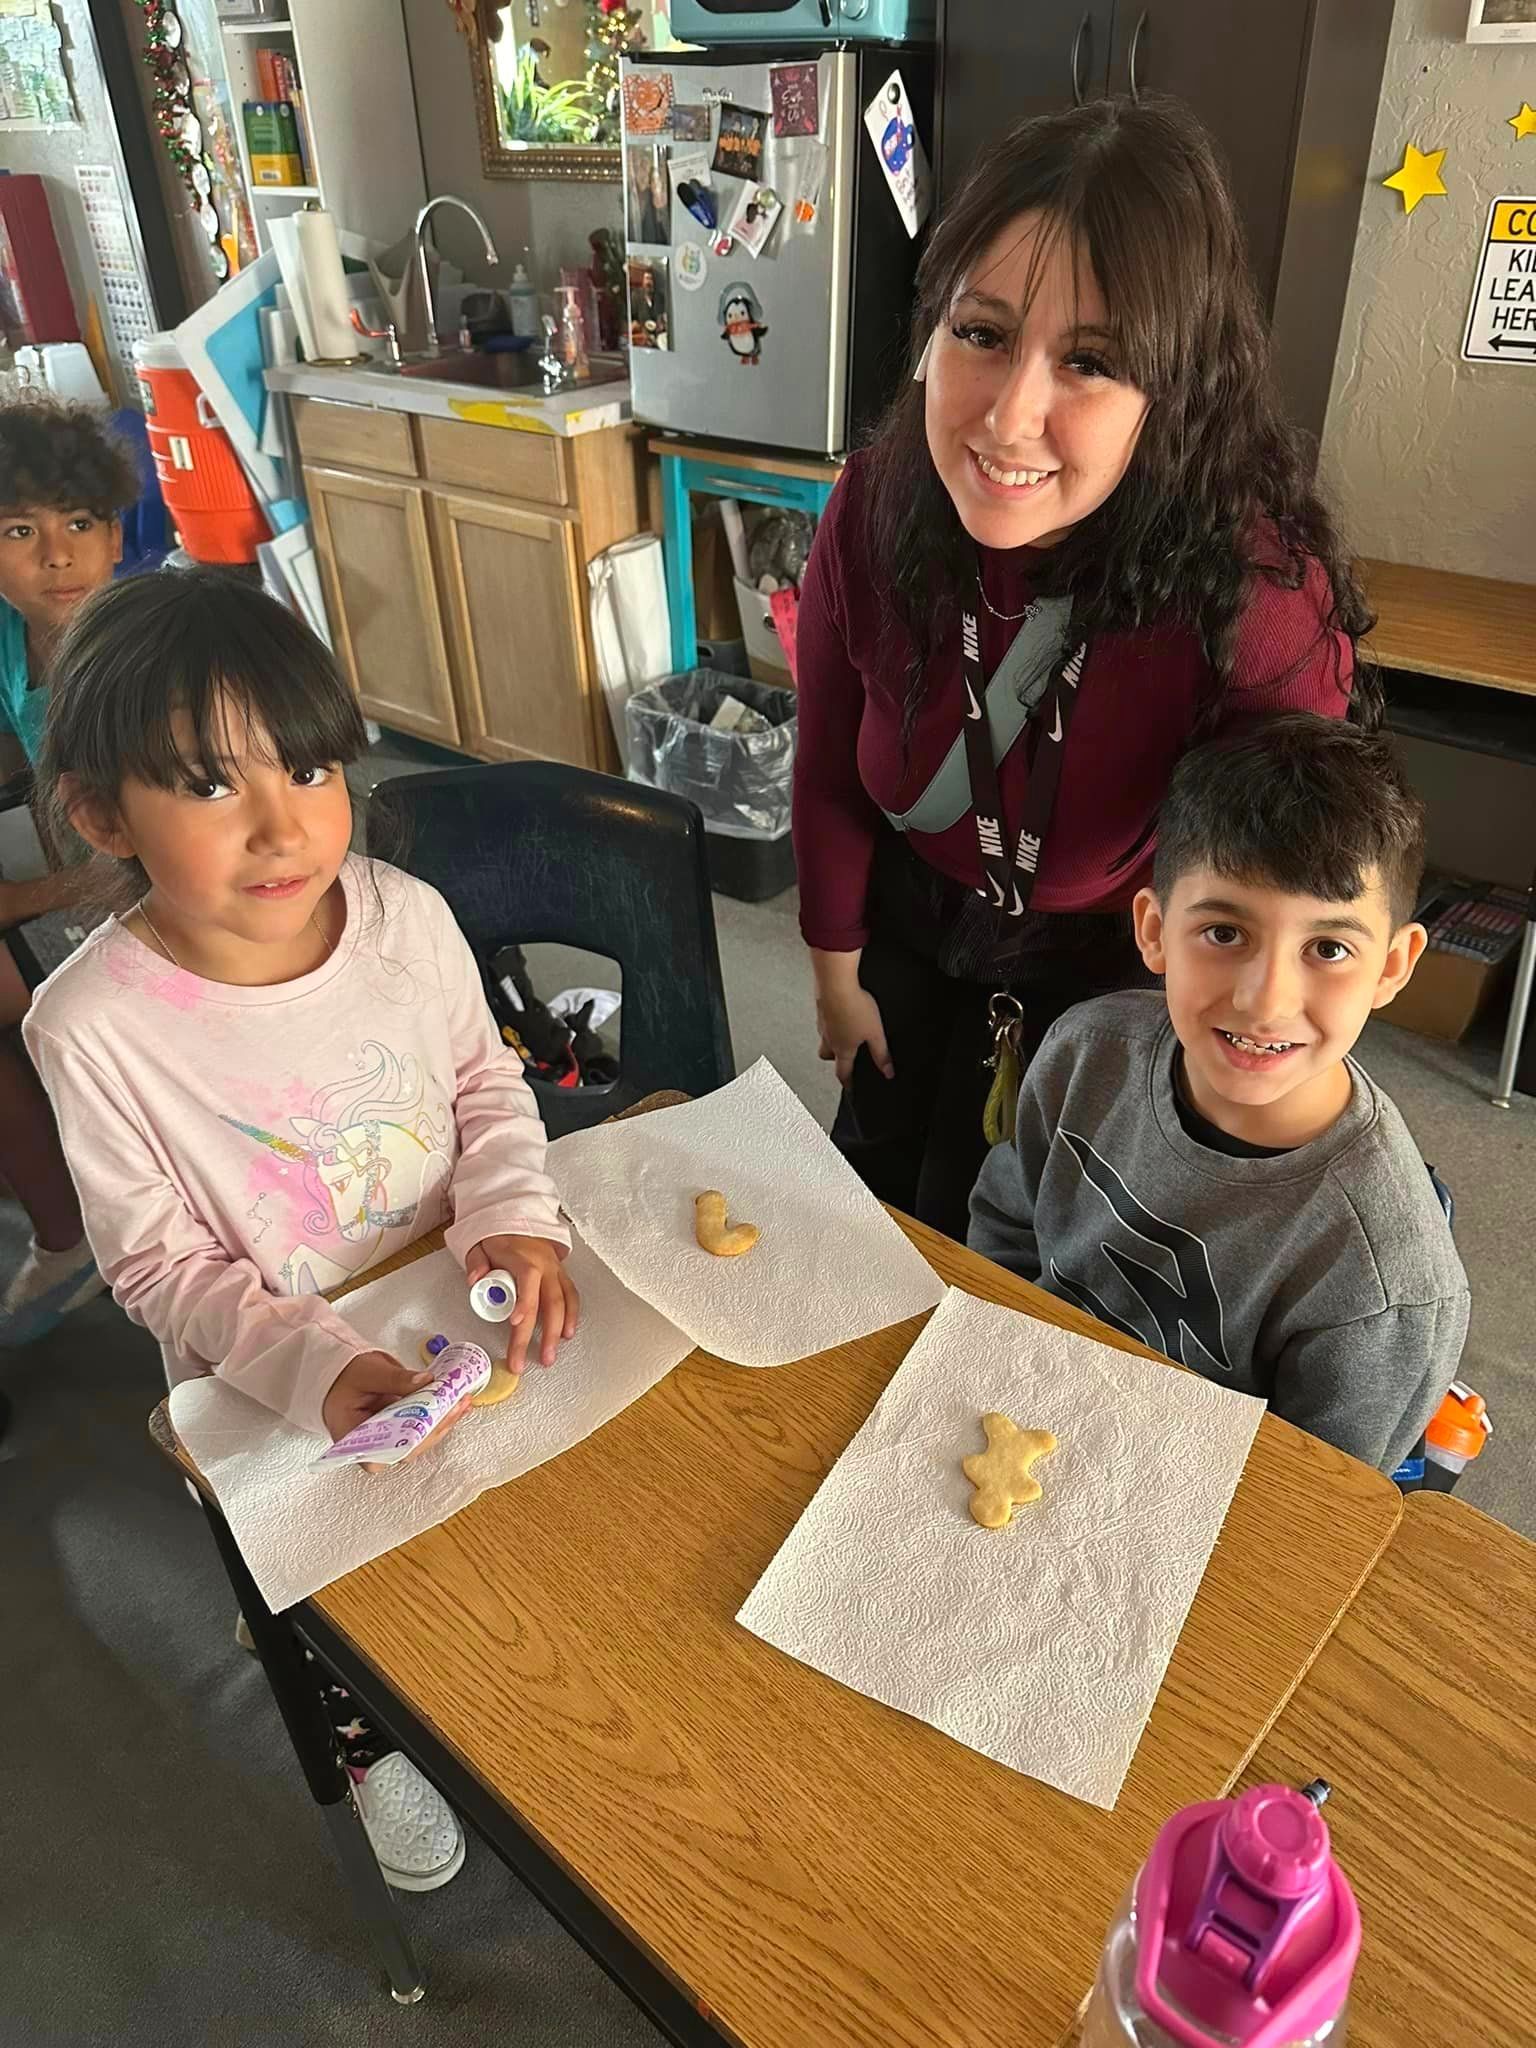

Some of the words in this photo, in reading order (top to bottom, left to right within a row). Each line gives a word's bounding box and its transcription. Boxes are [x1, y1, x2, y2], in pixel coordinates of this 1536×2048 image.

[963, 612, 980, 663] NIKE
[976, 815, 1005, 858] NIKE
[1015, 829, 1042, 873] NIKE
